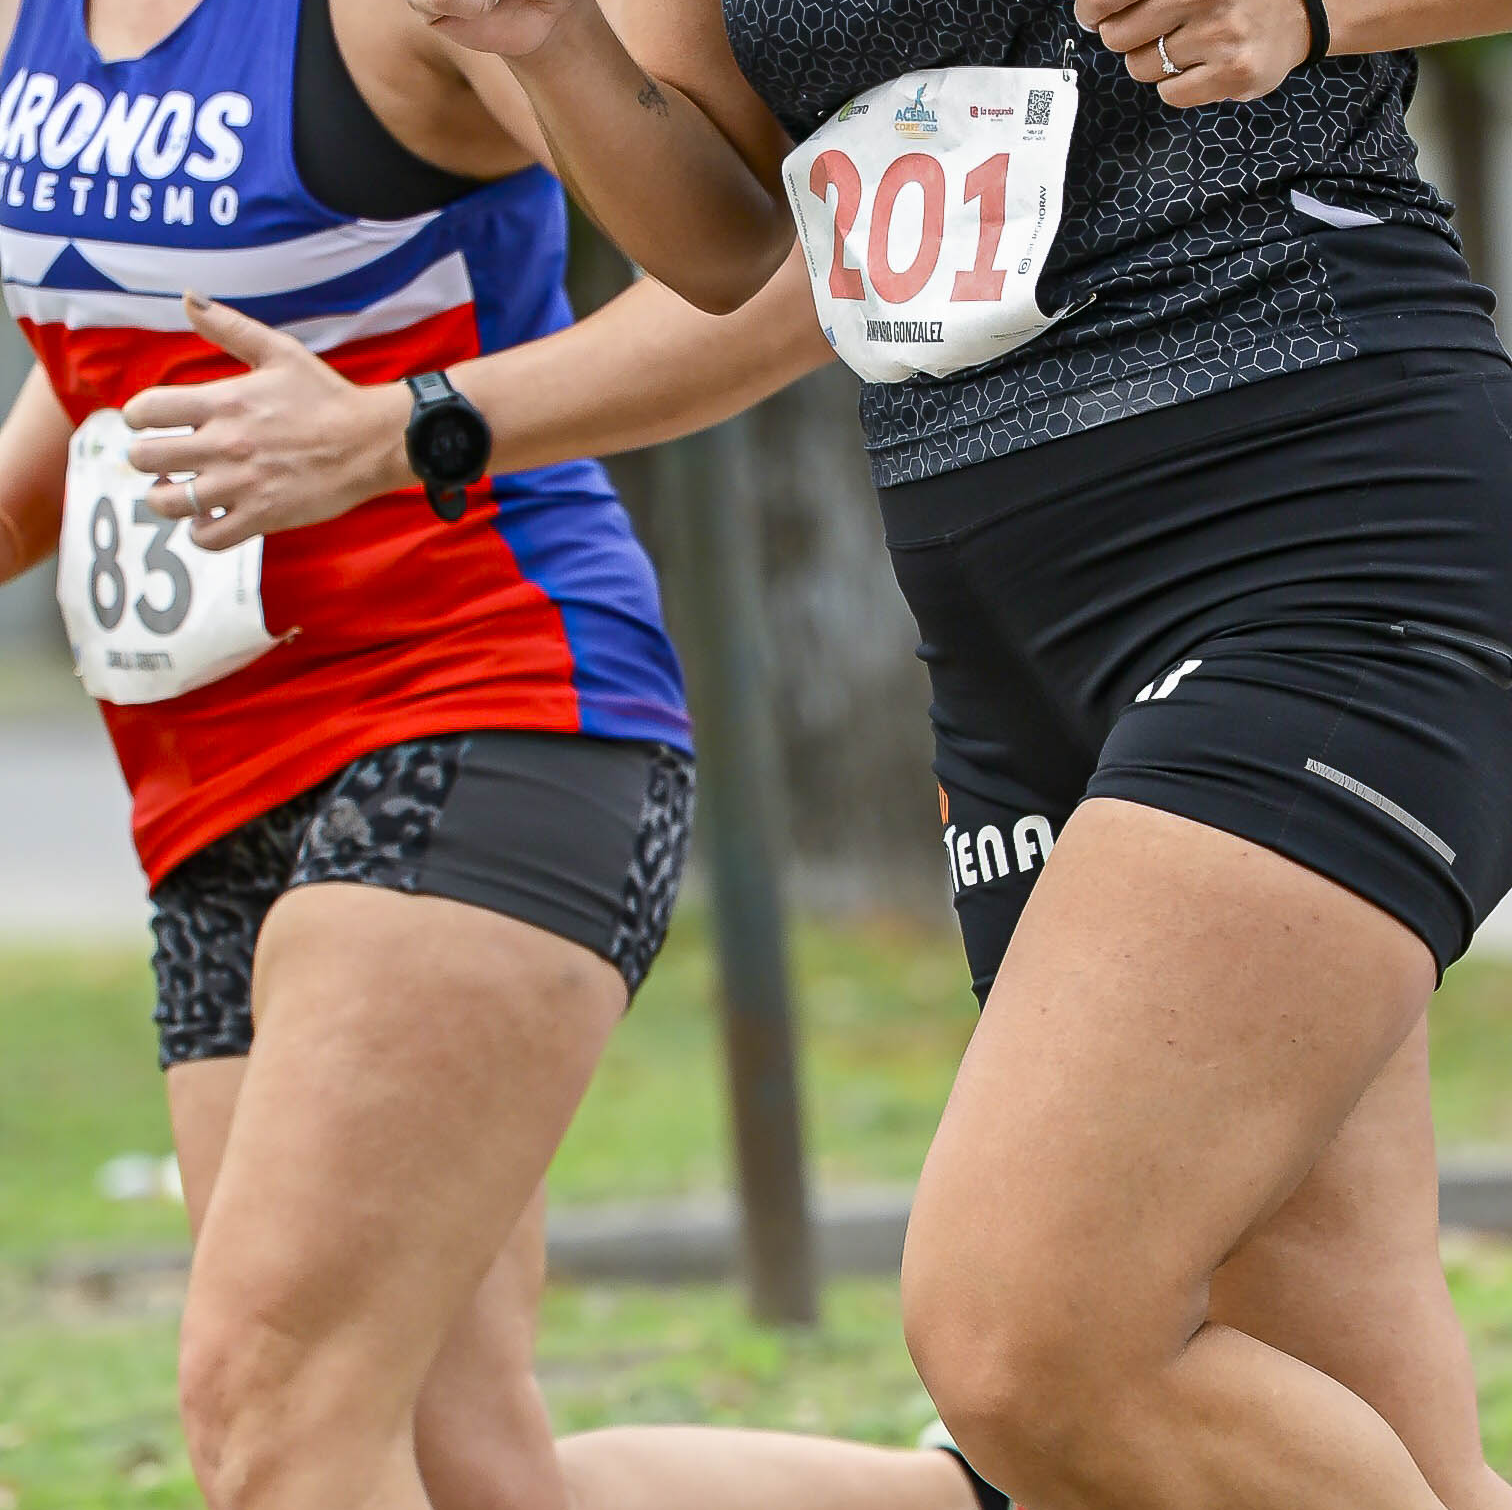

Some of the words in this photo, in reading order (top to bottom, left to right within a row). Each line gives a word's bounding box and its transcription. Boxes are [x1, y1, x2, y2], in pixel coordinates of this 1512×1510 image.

[809, 150, 1010, 304] 201
[893, 321, 944, 343] GONZALEZ
[89, 496, 192, 634] 83
[943, 815, 1054, 893] TENA
